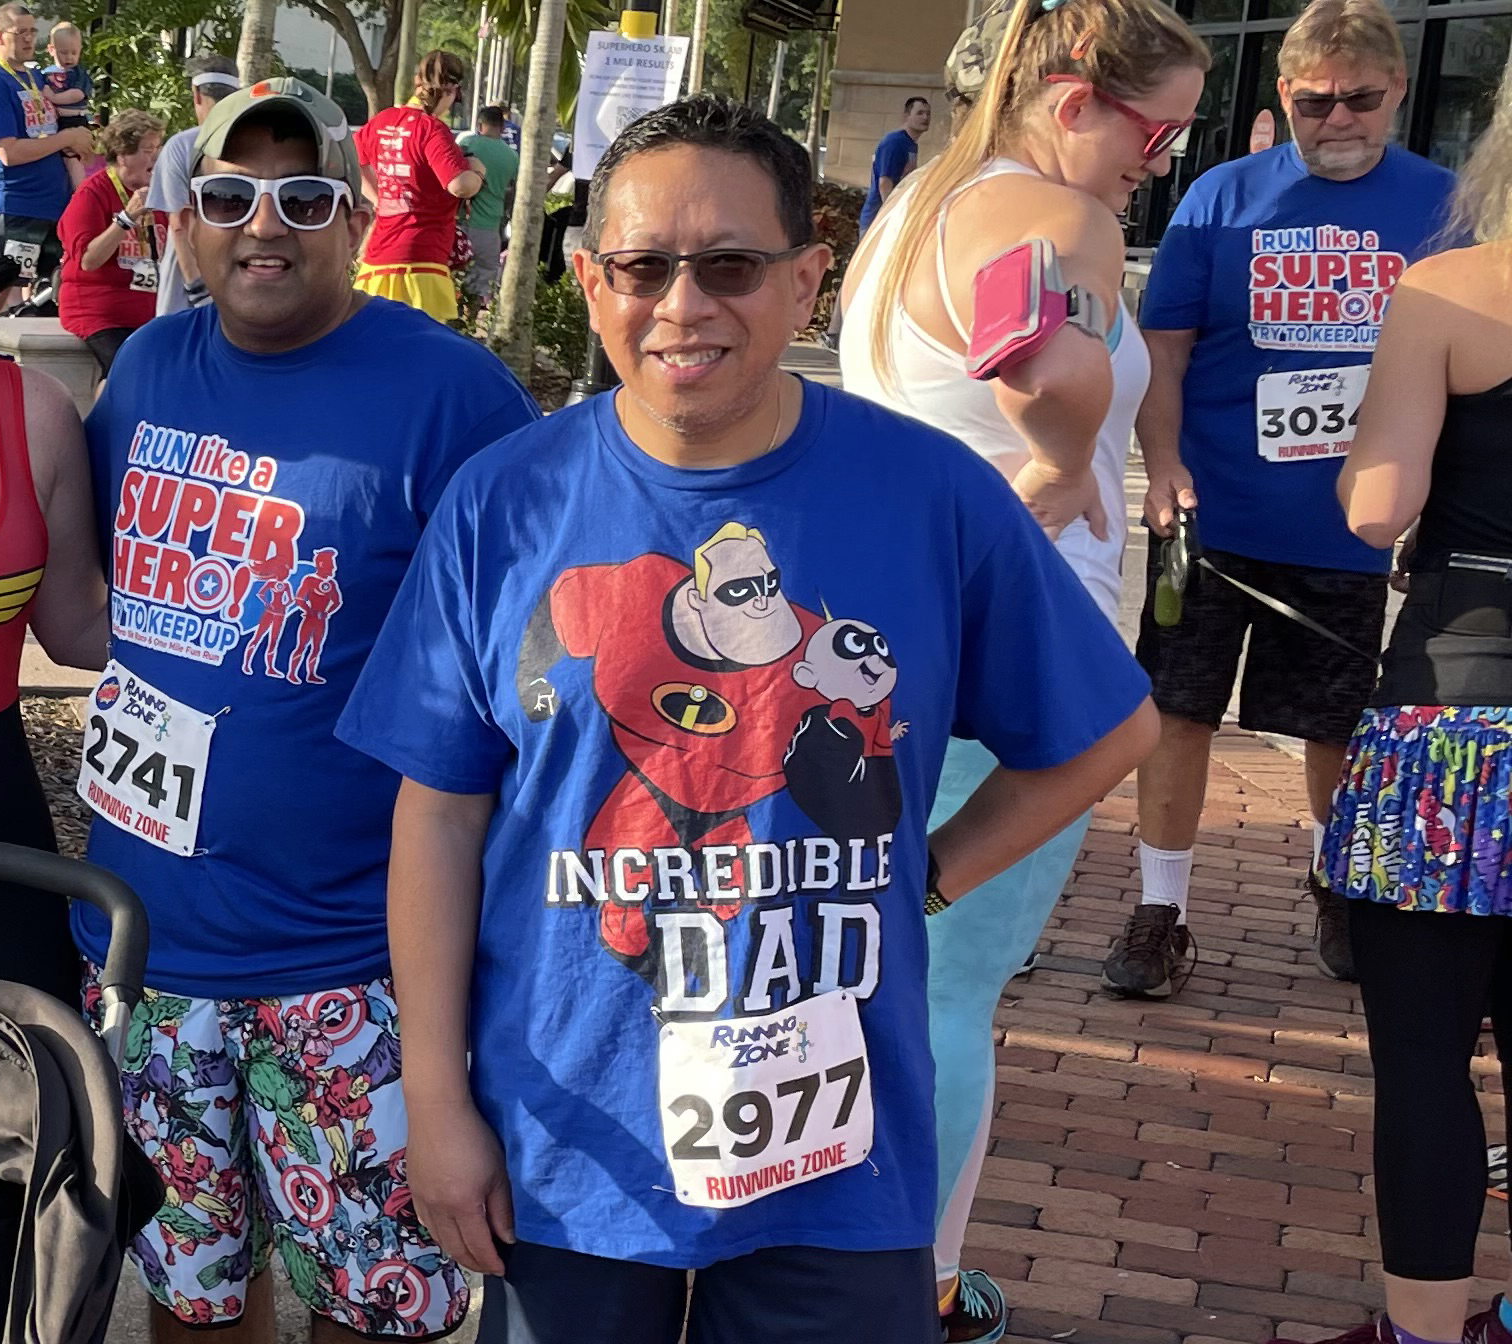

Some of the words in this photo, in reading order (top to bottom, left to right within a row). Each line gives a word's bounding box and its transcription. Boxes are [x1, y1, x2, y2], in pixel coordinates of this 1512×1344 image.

[597, 40, 651, 53] SUPERHERO
[653, 44, 665, 54] 5K
[613, 57, 634, 67] MILE
[636, 59, 675, 70] RESULTS
[1319, 226, 1357, 248] like
[1364, 234, 1377, 249] a
[1252, 253, 1404, 289] SUPER
[1252, 326, 1281, 341] TRY
[1286, 327, 1309, 342] TO
[1311, 327, 1354, 343] KEEP
[1296, 381, 1333, 394] ZONE
[192, 438, 246, 482] like
[252, 460, 274, 488] a
[1278, 442, 1330, 458] RUNNING
[116, 470, 302, 566] SUPER
[126, 602, 145, 630] TO
[148, 608, 199, 643] KEEP
[203, 622, 236, 652] UP
[168, 641, 184, 653] Mile
[185, 645, 201, 658] Fun
[202, 649, 220, 662] Run
[122, 696, 157, 726] ZONE
[85, 714, 196, 822] 2741
[87, 779, 133, 827] RUNNING
[134, 811, 171, 845] ZONE
[545, 832, 893, 904] INCREDIBLE
[655, 902, 881, 1014] DAD
[710, 1015, 797, 1049] RUNNING
[728, 1037, 791, 1069] ZONE
[667, 1055, 866, 1160] 2977
[705, 1159, 796, 1201] RUNNING
[801, 1141, 848, 1177] ZONE
